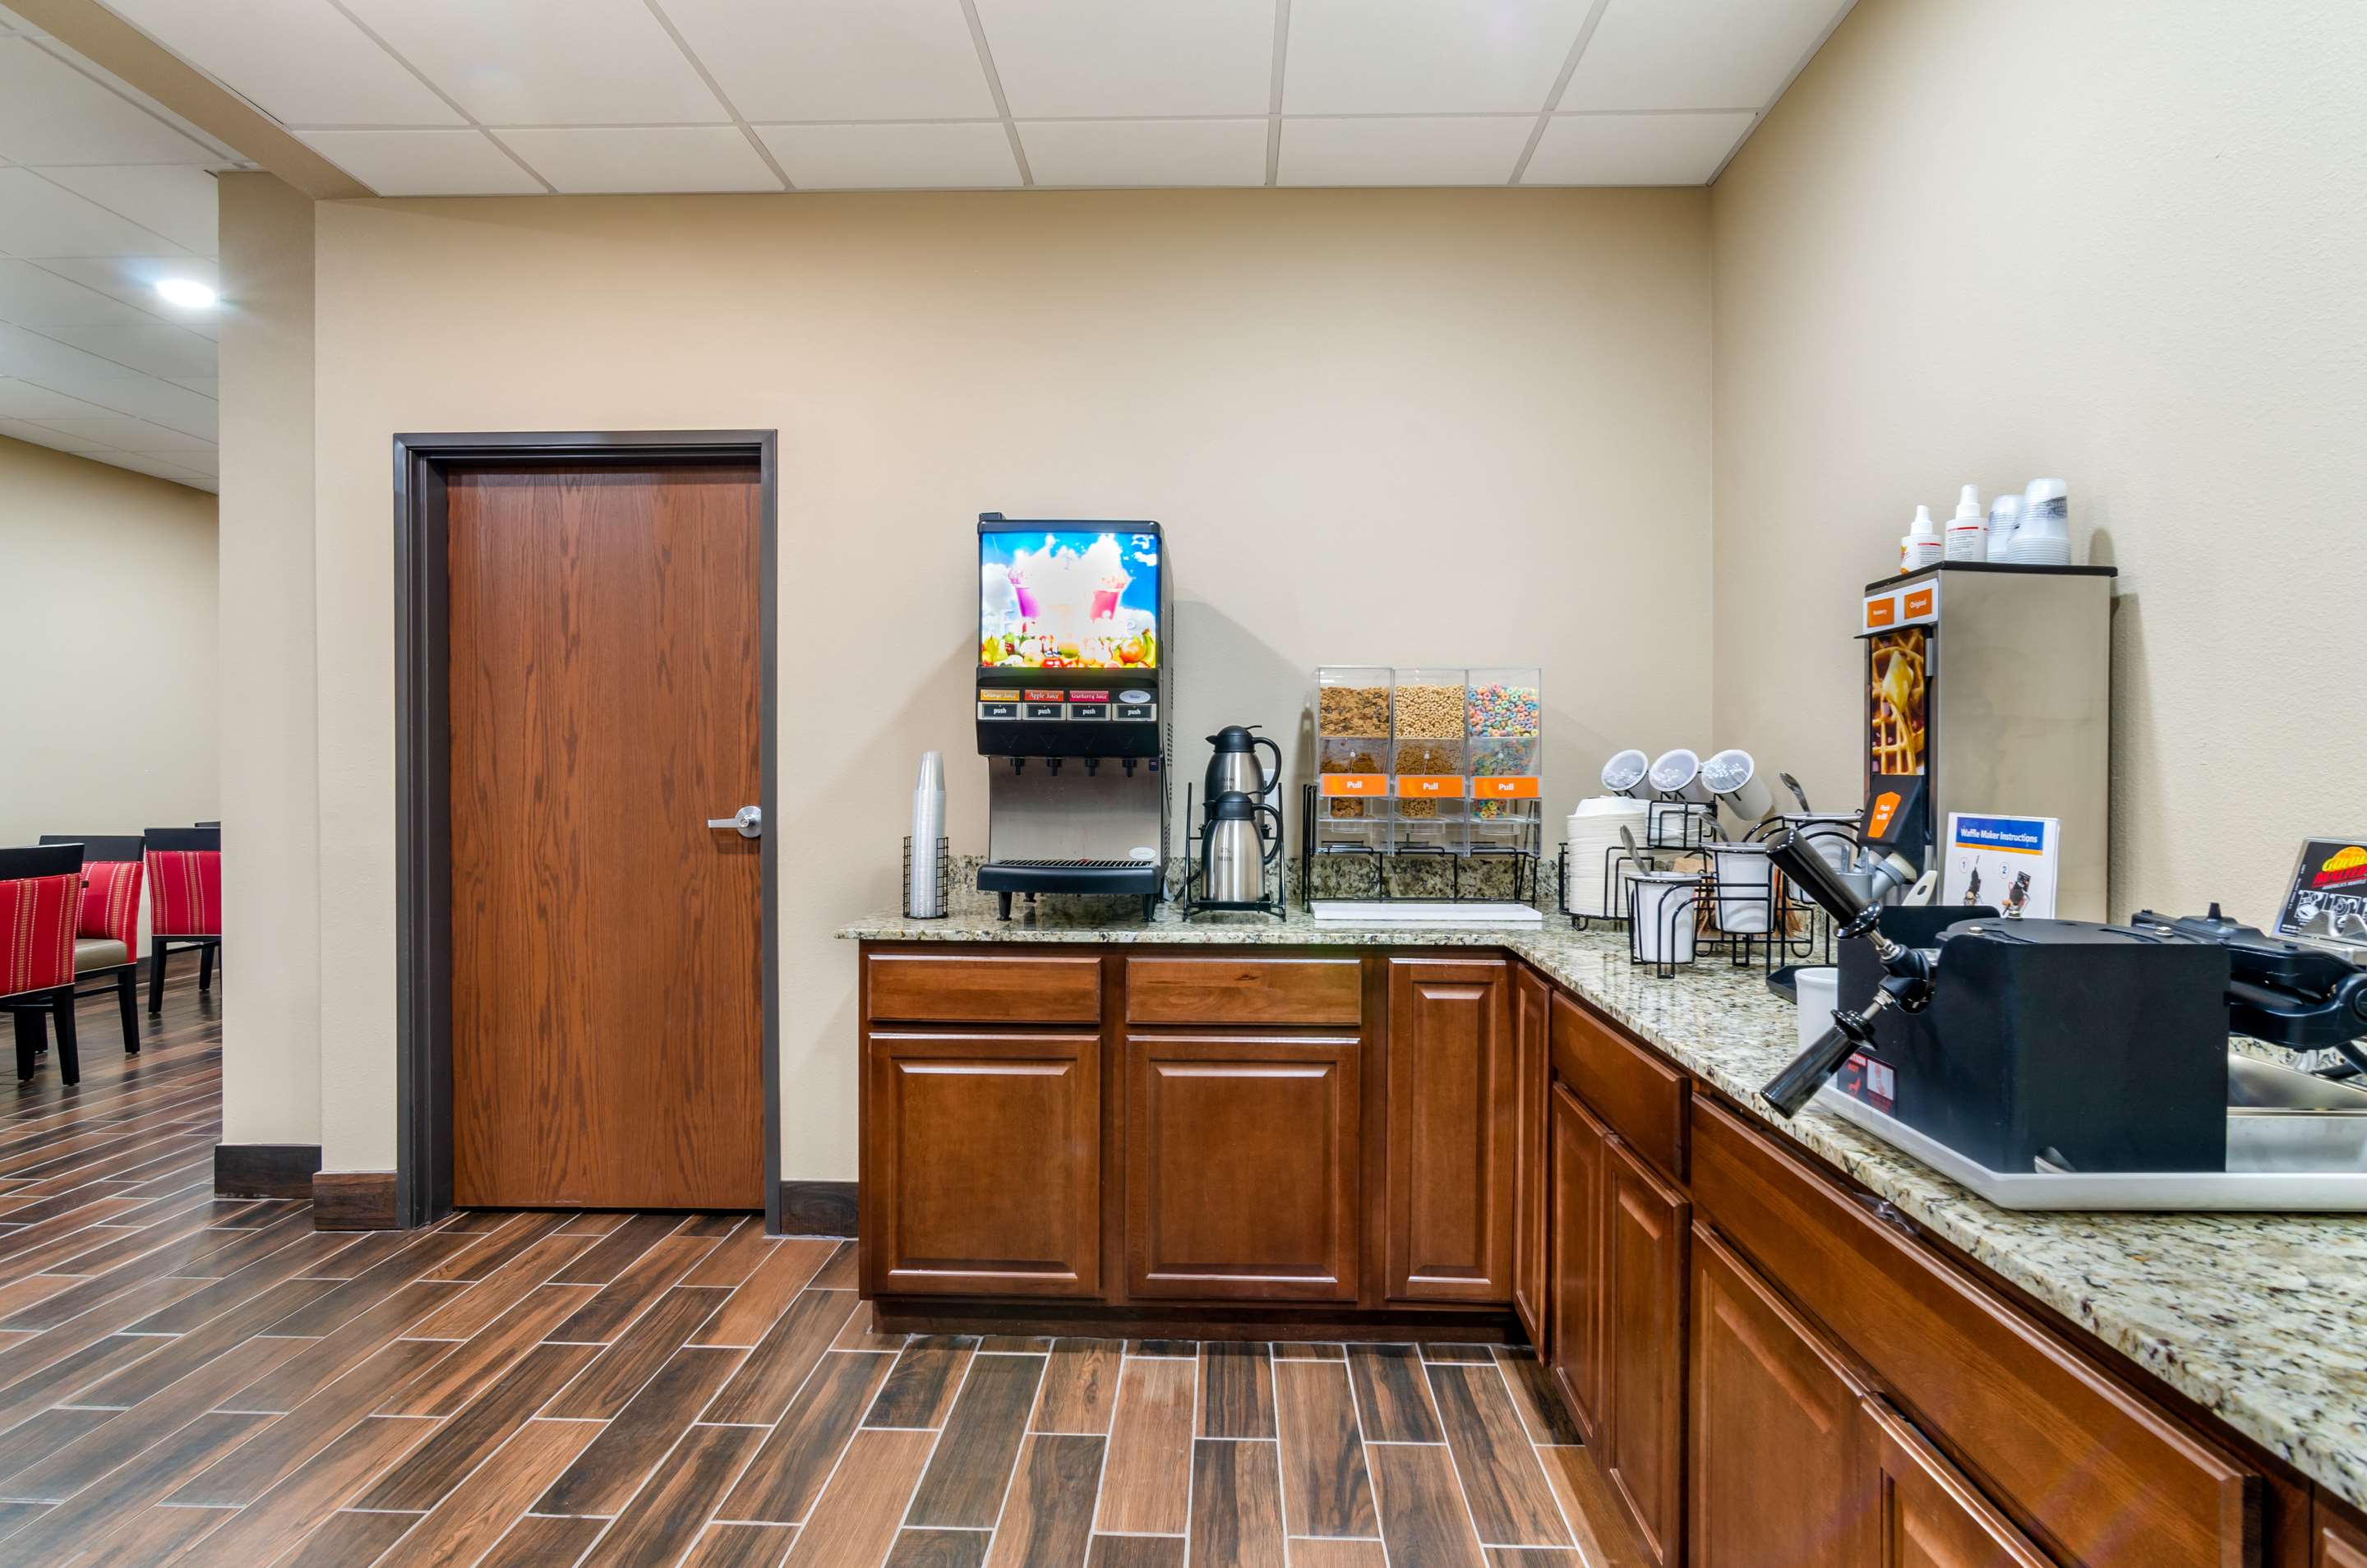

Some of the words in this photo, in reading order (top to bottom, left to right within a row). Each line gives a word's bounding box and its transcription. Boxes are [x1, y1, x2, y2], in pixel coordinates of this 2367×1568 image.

[1029, 692, 1044, 700] Apple
[1128, 708, 1142, 717] push
[1960, 828, 1980, 838] Waffle
[1980, 829, 2000, 840] Maker
[2000, 831, 2038, 843] Instructions
[2002, 865, 2007, 874] 2
